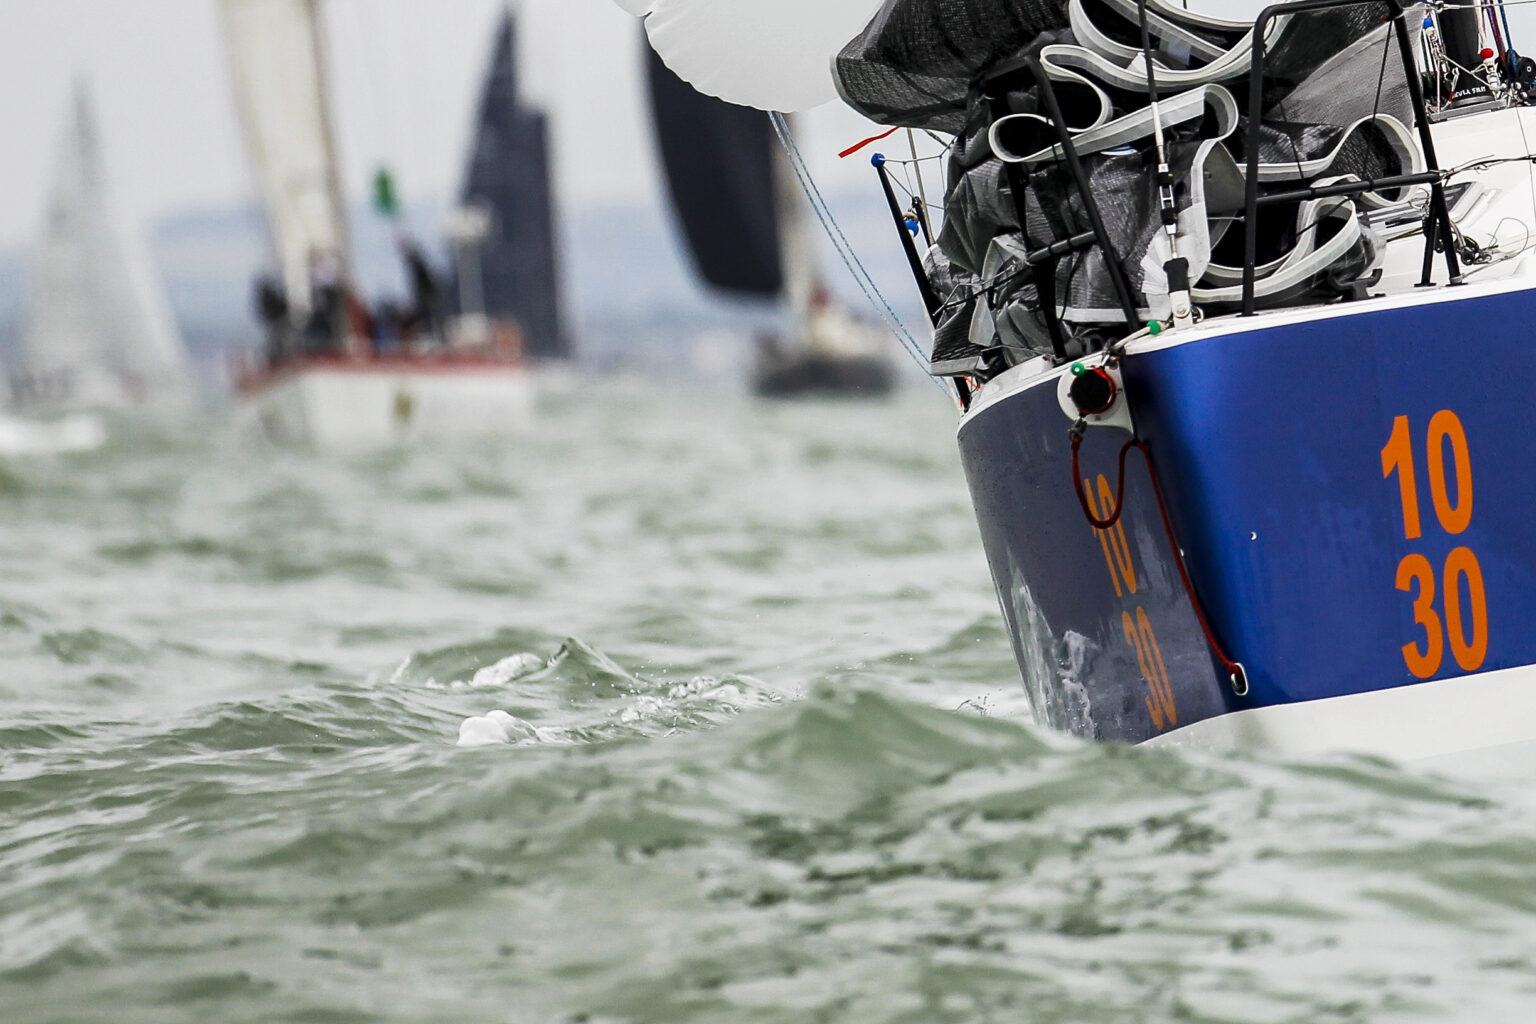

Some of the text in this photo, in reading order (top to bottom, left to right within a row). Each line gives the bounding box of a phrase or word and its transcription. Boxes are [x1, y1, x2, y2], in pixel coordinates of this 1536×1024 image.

[1084, 474, 1137, 597] 10
[1381, 409, 1473, 539] 10
[1121, 605, 1177, 730] 30
[1395, 546, 1488, 679] 30
